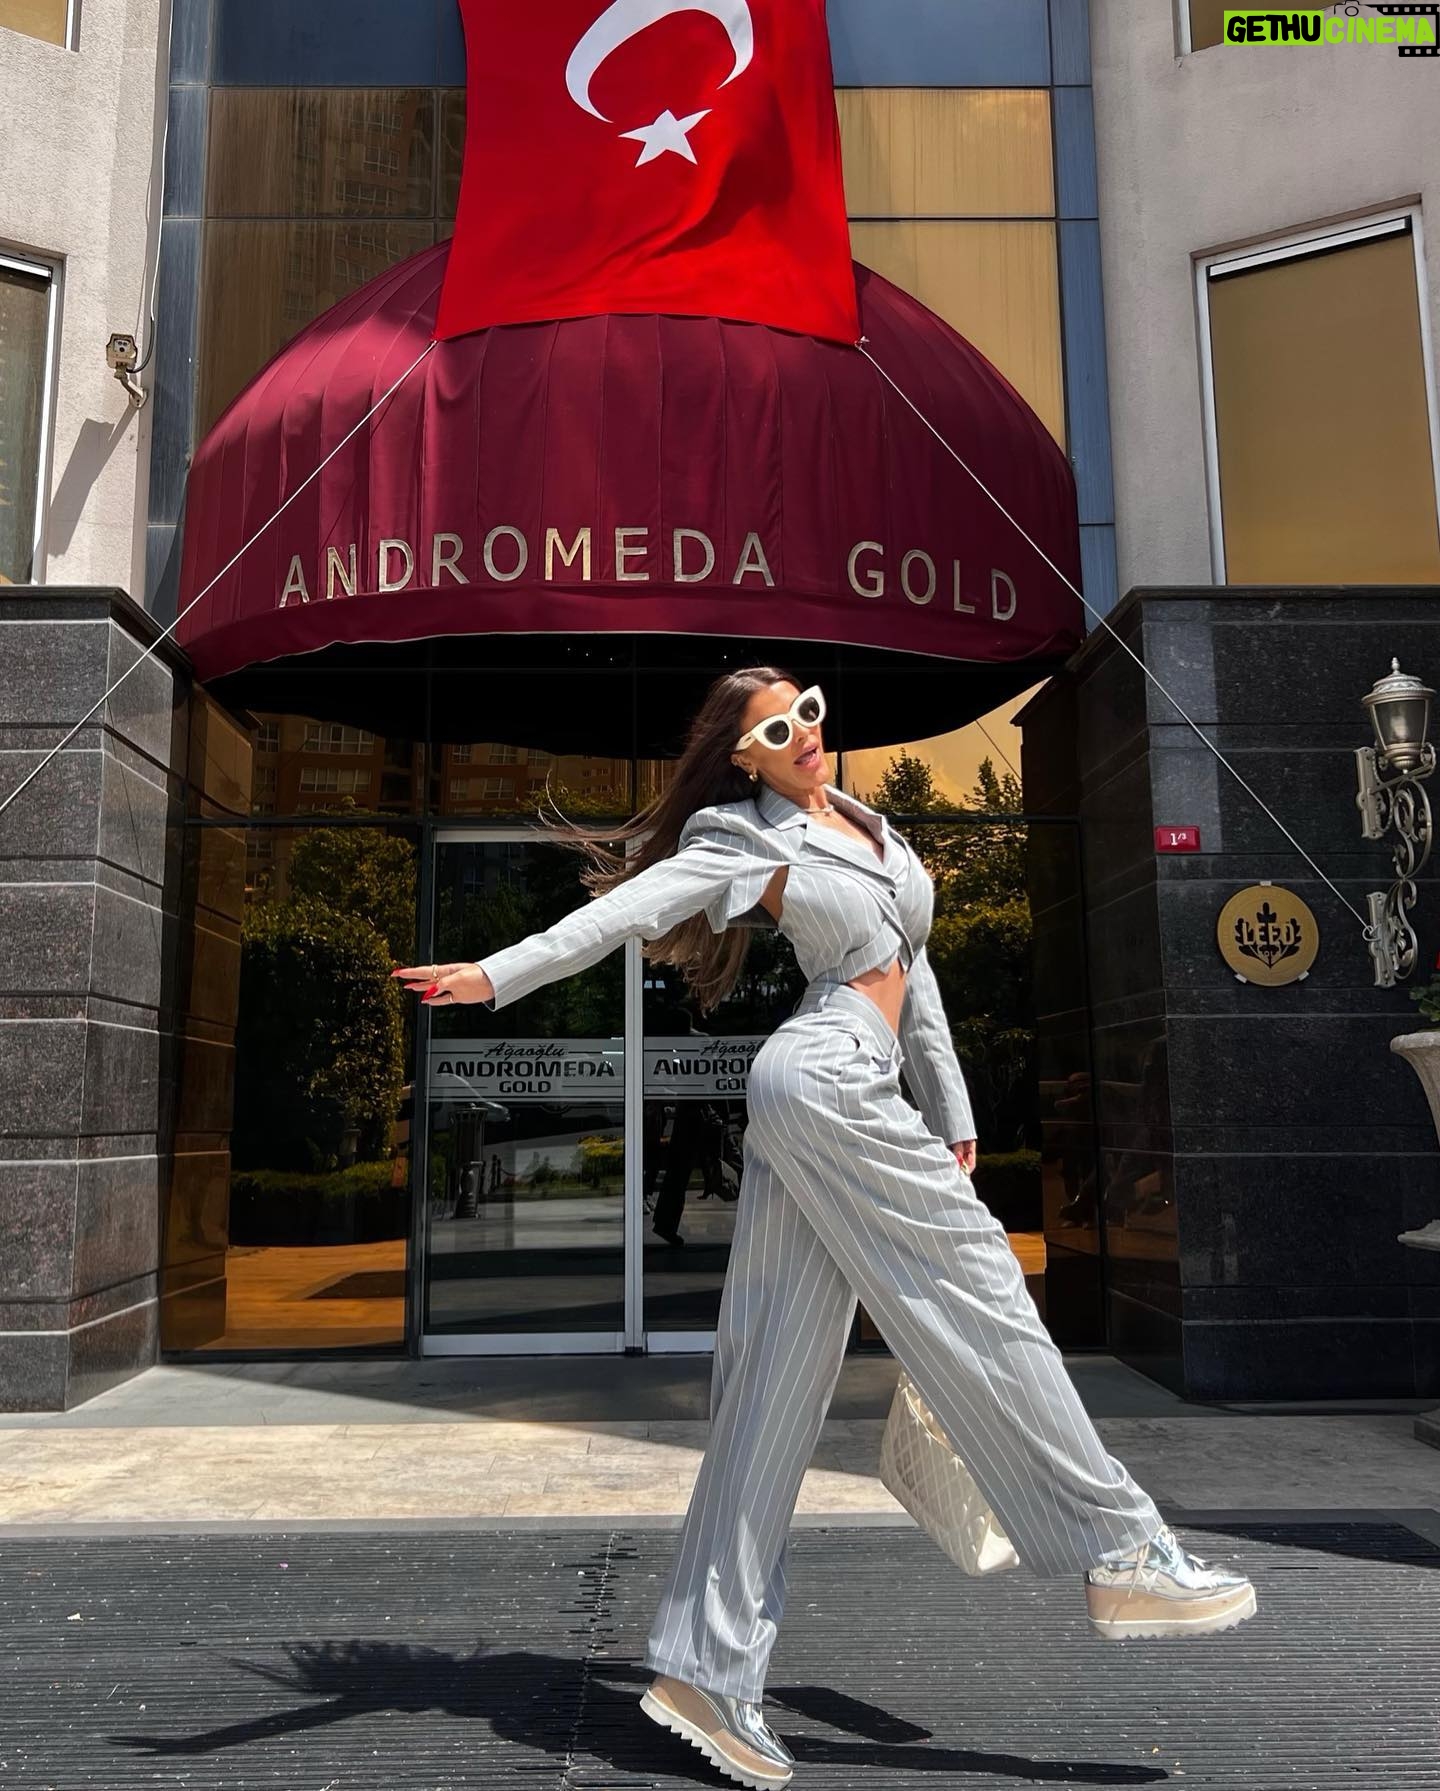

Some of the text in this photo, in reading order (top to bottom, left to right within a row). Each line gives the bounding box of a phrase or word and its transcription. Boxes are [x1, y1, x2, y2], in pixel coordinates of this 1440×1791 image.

[279, 525, 1017, 621] ANDROMEDA GOLD
[1242, 922, 1296, 945] LEED
[701, 1039, 766, 1058] Ağaoğl
[436, 1060, 615, 1078] ANDROMEDA
[499, 1080, 551, 1094] GOLD
[715, 1077, 748, 1091] GOL
